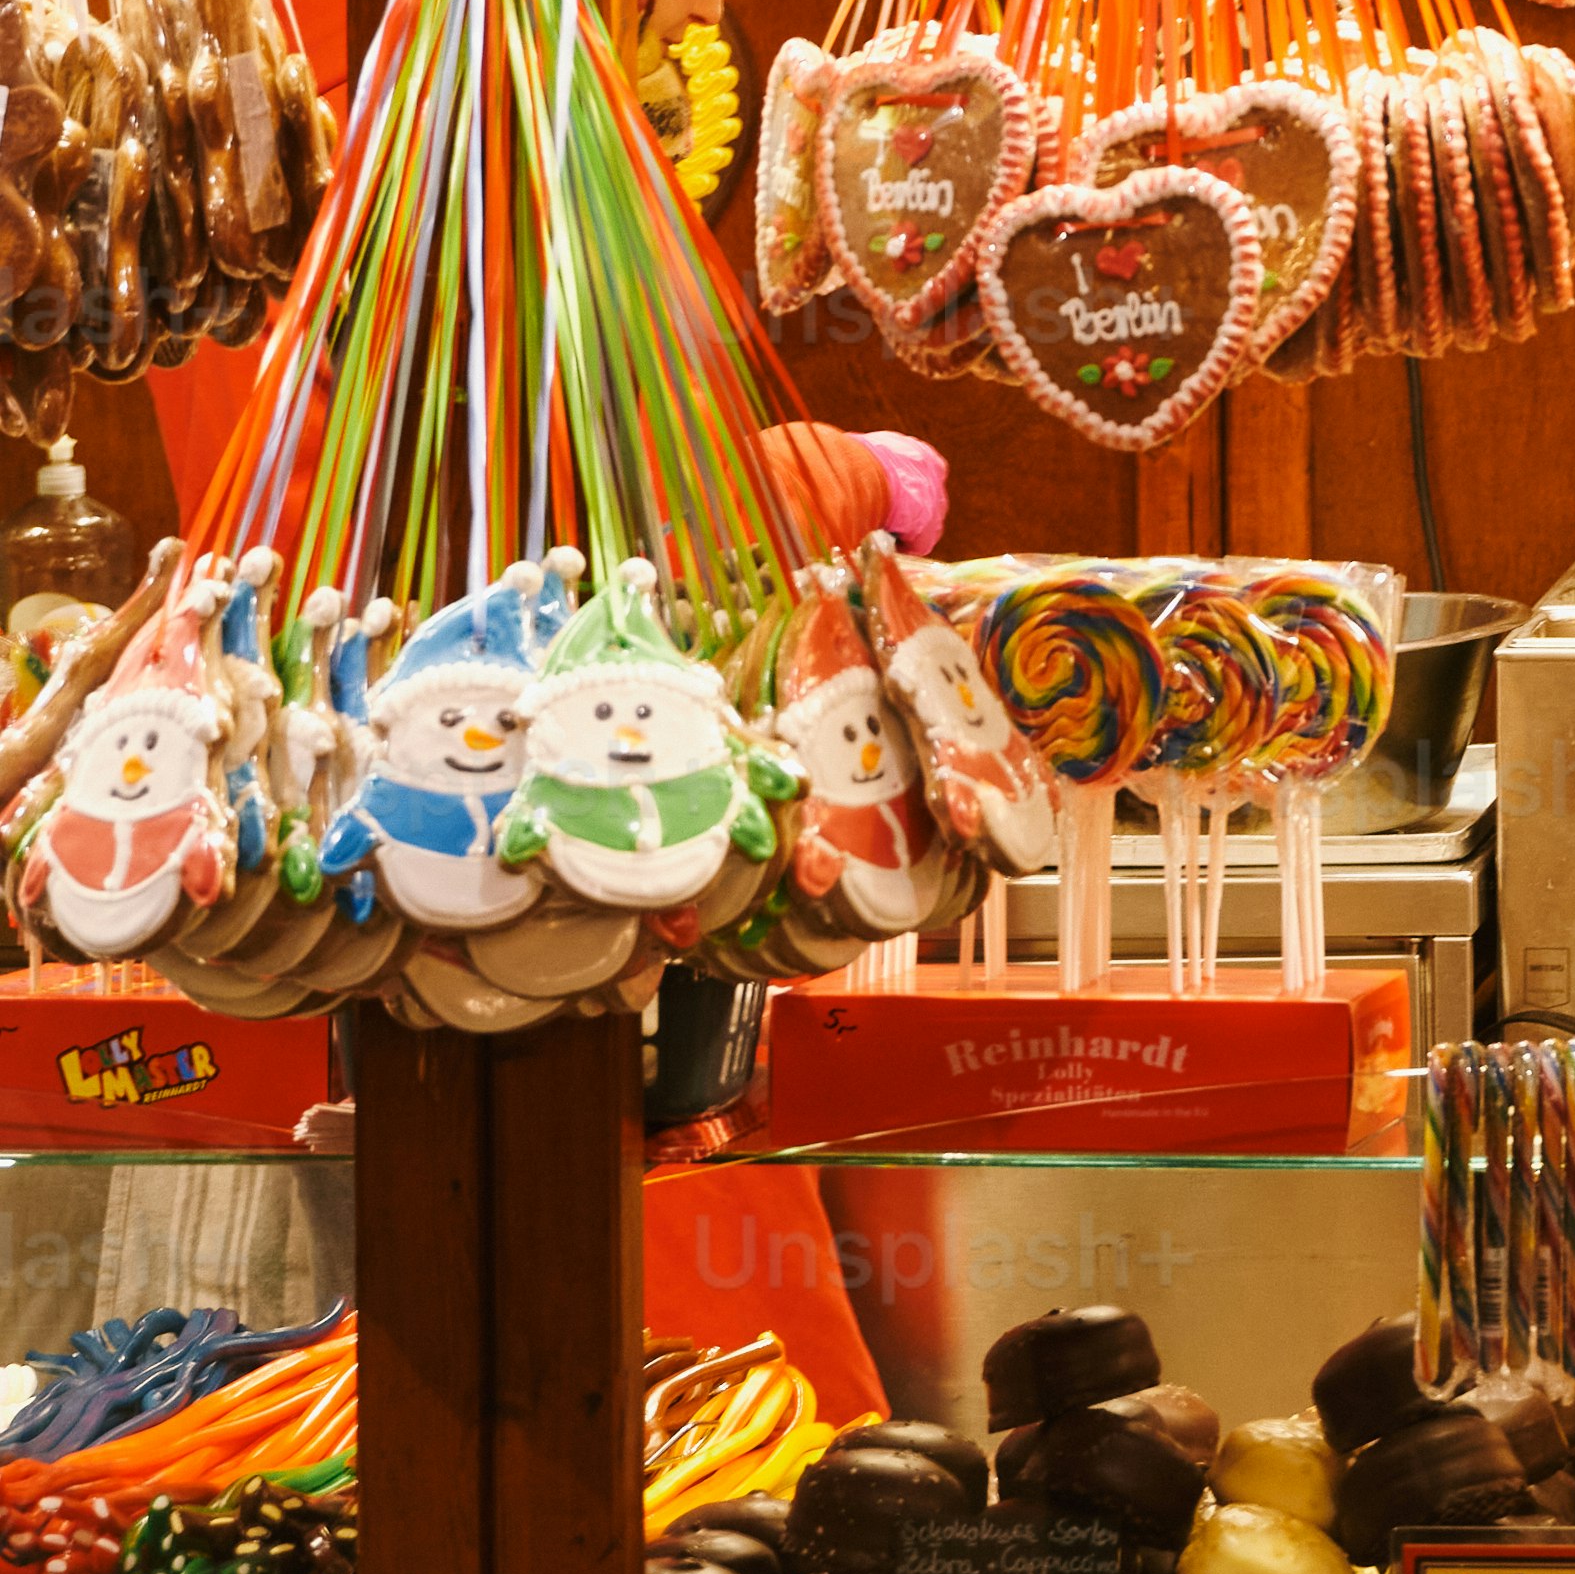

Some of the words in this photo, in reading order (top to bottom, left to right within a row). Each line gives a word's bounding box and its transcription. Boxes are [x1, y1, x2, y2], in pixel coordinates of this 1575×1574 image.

[860, 167, 954, 219] Berlin
[1058, 291, 1184, 345] Berlin
[944, 1025, 1189, 1077] Reinhardt
[1037, 1062, 1095, 1089] Lolly
